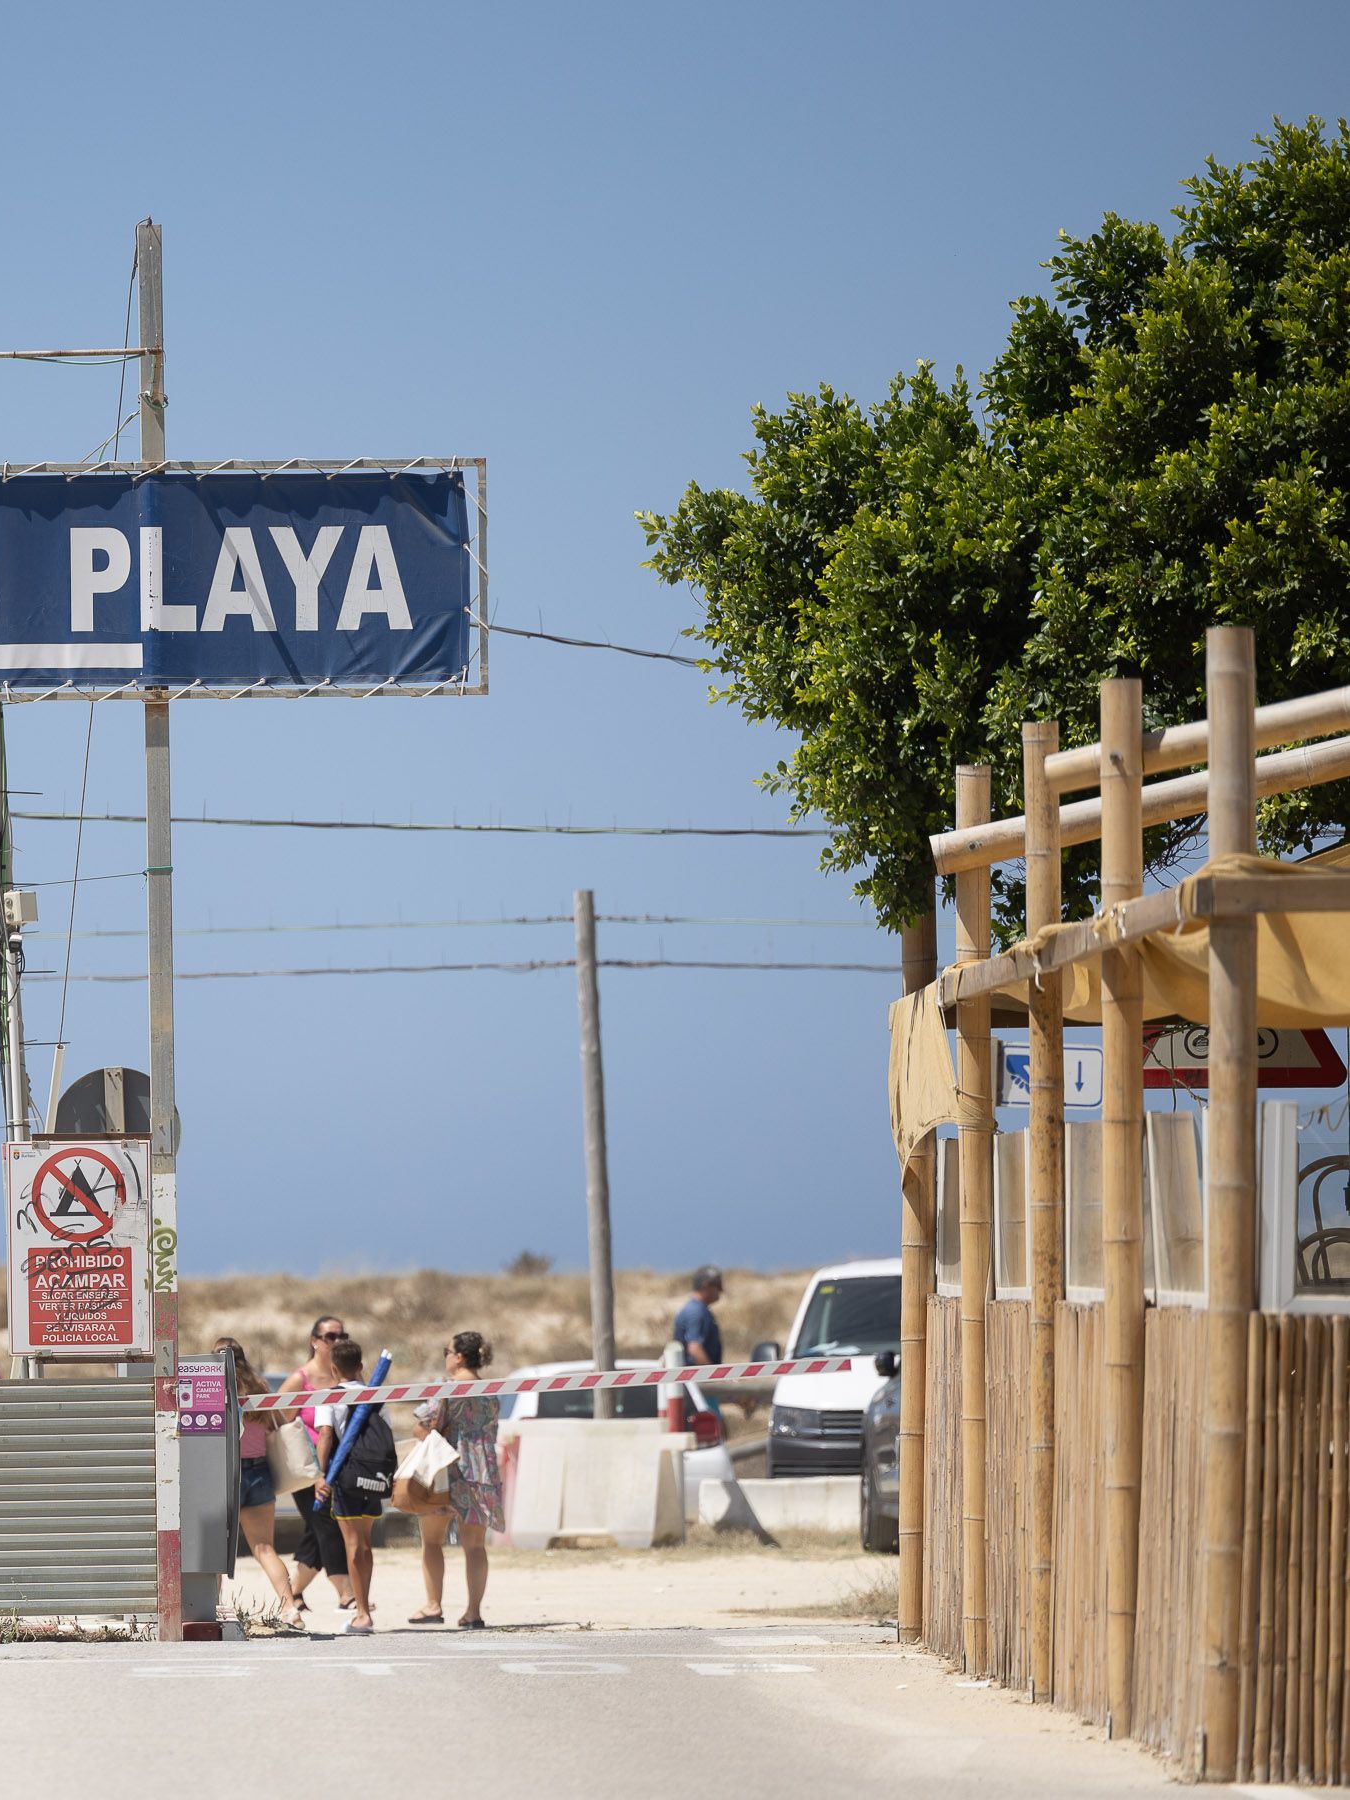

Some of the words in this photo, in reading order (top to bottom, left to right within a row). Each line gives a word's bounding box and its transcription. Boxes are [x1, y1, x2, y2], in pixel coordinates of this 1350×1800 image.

[70, 525, 413, 632] PLAYA
[35, 1254, 125, 1268] PROHIBIDO
[35, 1273, 126, 1288] ACAMPAR
[42, 1291, 74, 1300] SACAR
[76, 1291, 120, 1299] ENSERES
[38, 1302, 76, 1310] VERTER
[46, 1324, 59, 1332] SE
[108, 1324, 116, 1332] A
[42, 1334, 83, 1342] POLICIA
[85, 1334, 120, 1342] LOCAL
